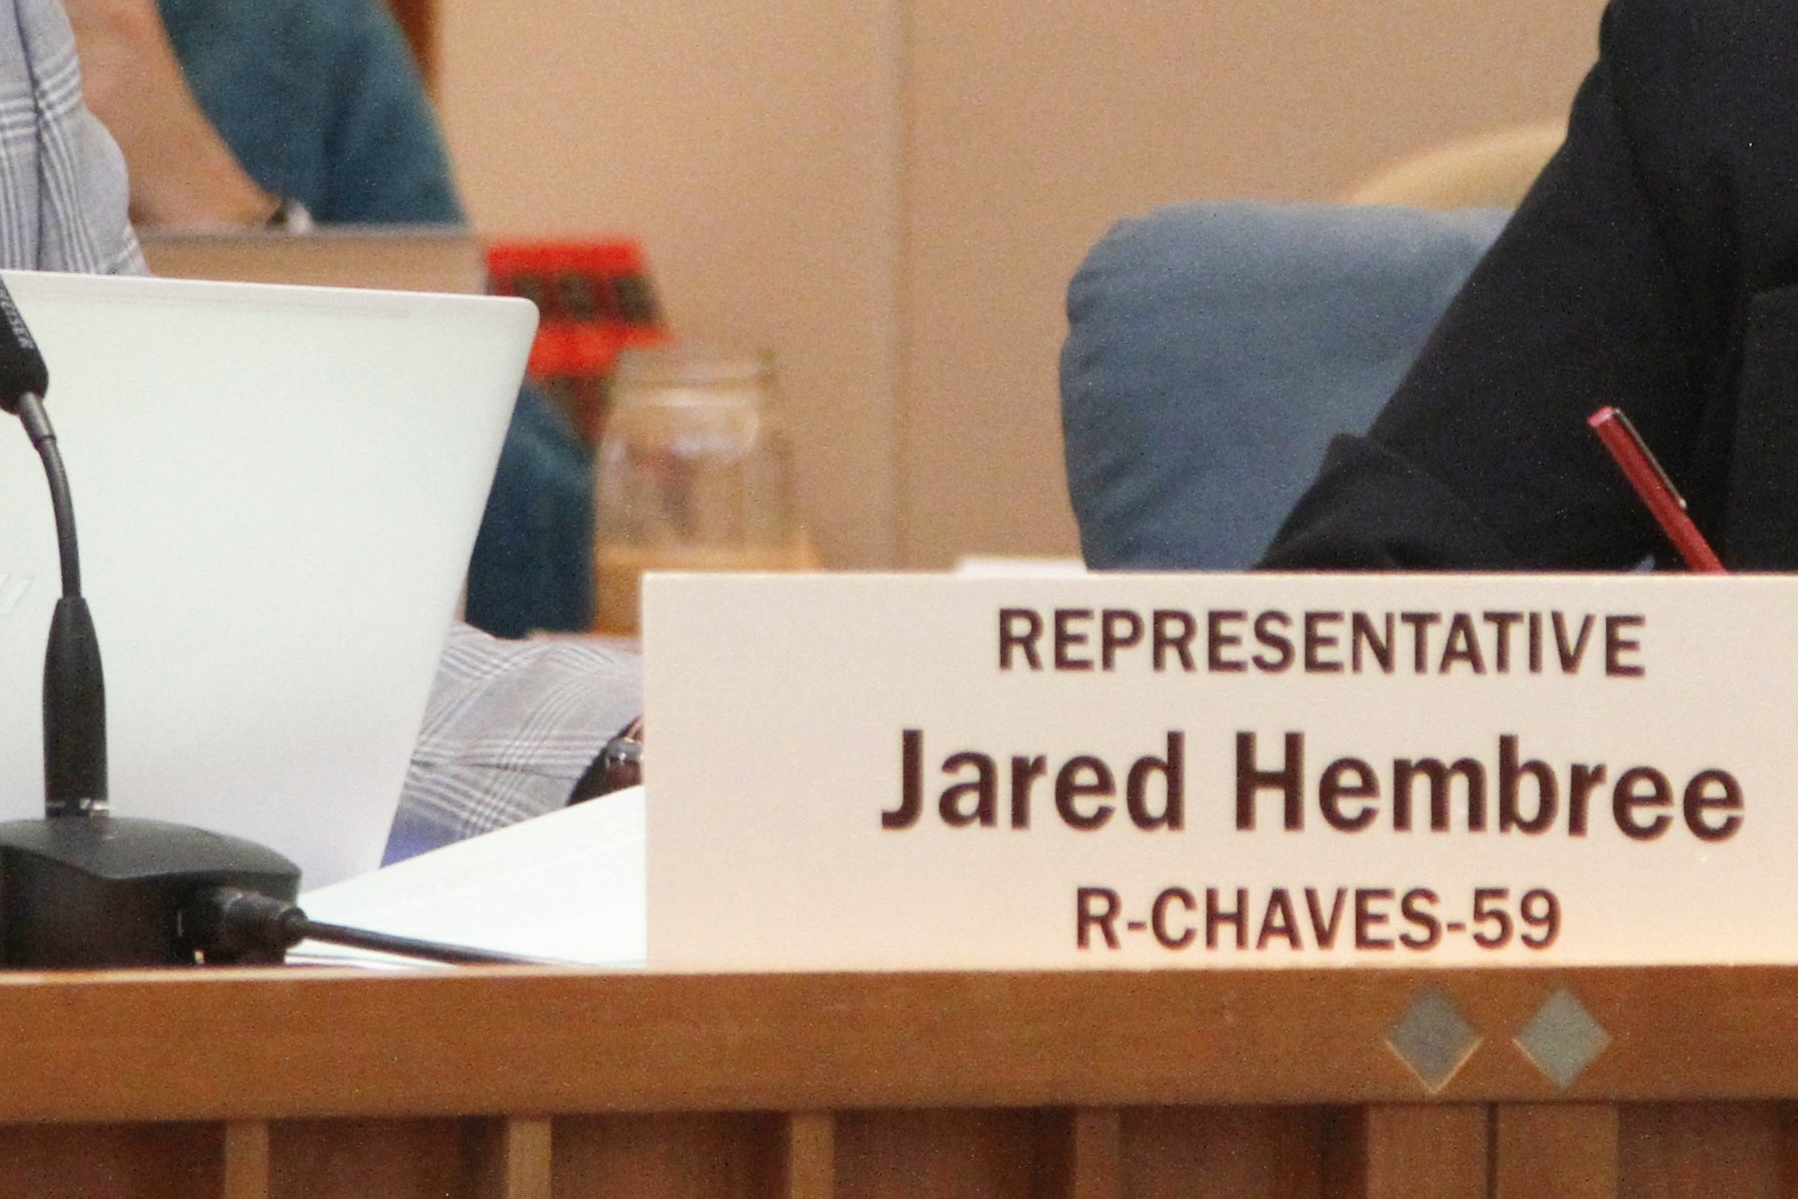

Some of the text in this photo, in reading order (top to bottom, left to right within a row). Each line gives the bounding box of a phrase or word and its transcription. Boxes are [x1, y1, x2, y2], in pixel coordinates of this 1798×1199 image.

[999, 608, 1645, 677] REPRESENTATIVE
[881, 728, 1745, 843] Jared Hembree
[1075, 887, 1561, 952] R-CHAVES-59
